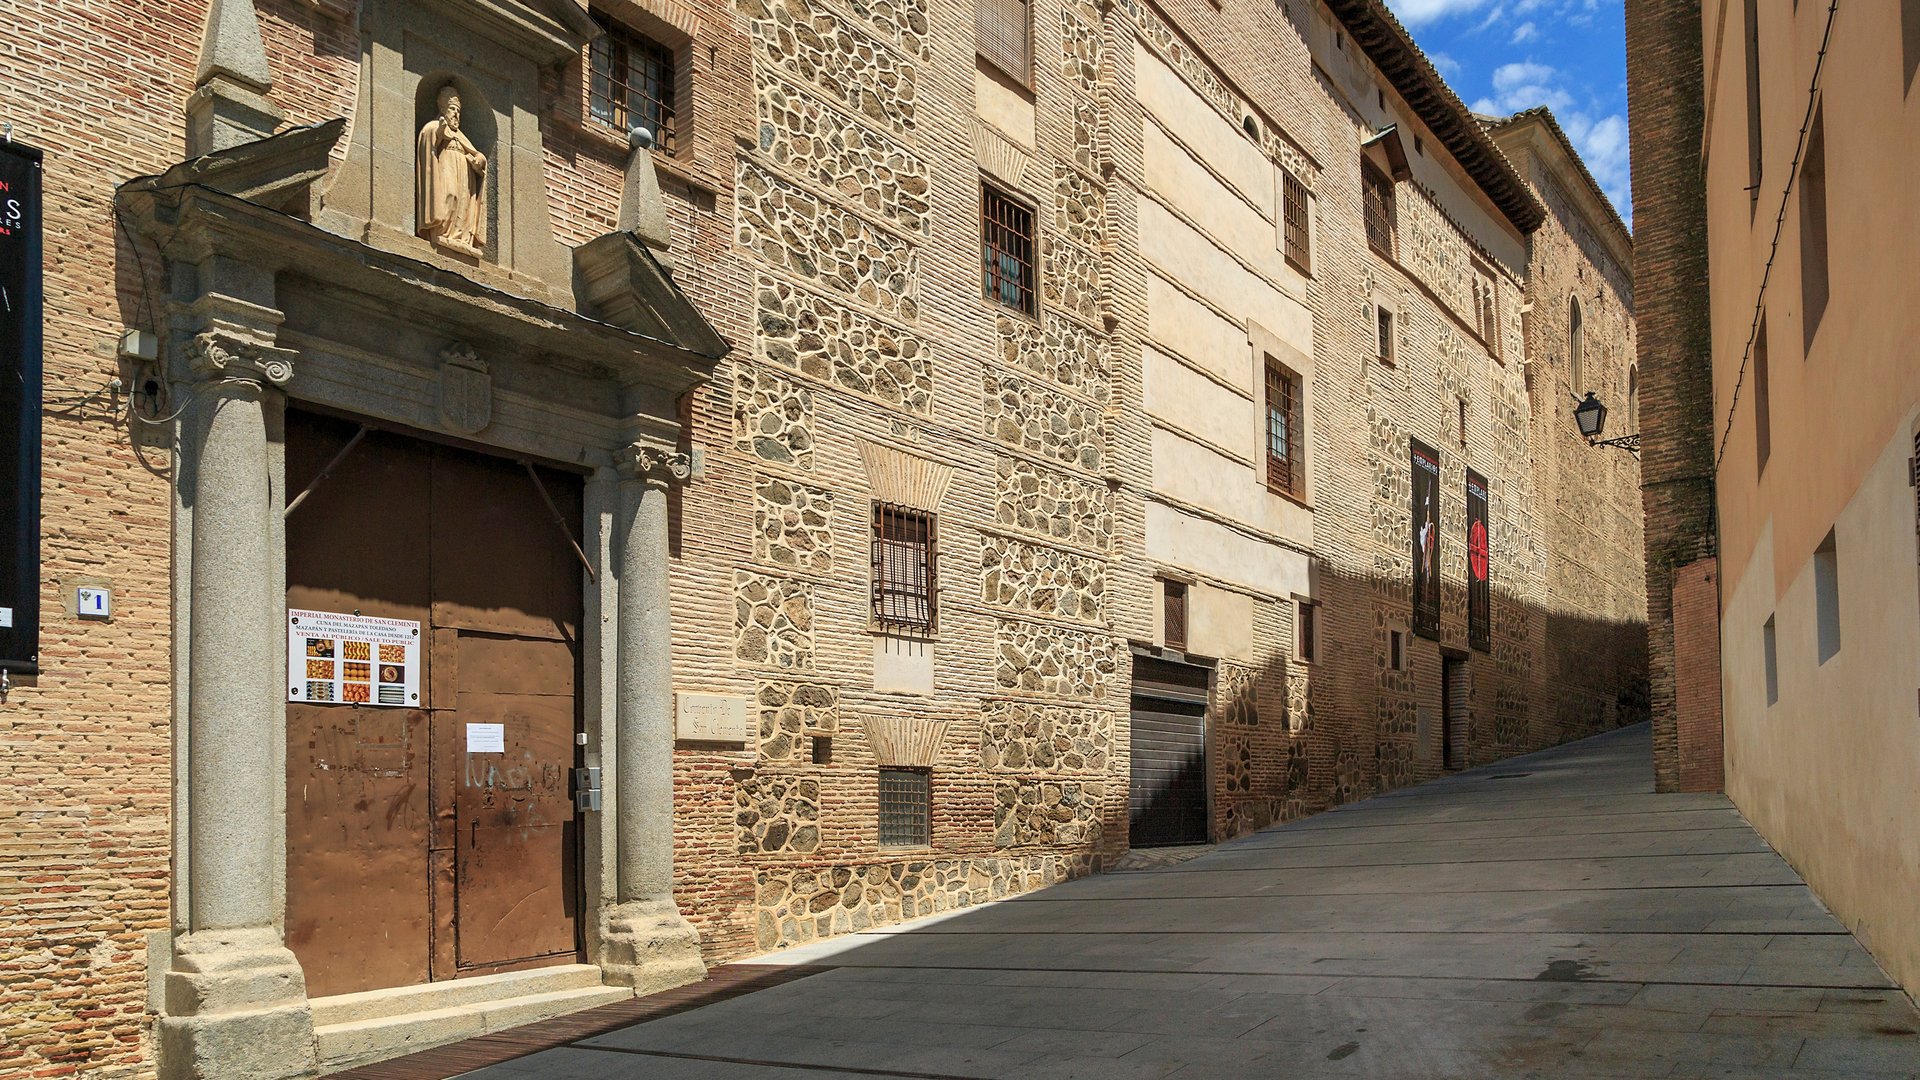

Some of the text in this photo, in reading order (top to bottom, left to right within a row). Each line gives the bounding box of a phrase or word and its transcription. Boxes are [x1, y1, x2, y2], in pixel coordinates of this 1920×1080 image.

[94, 594, 102, 610] 1
[291, 611, 322, 619] IMPERIAL
[324, 614, 364, 623] MONASTERIO
[387, 620, 419, 628] CLEMENTE
